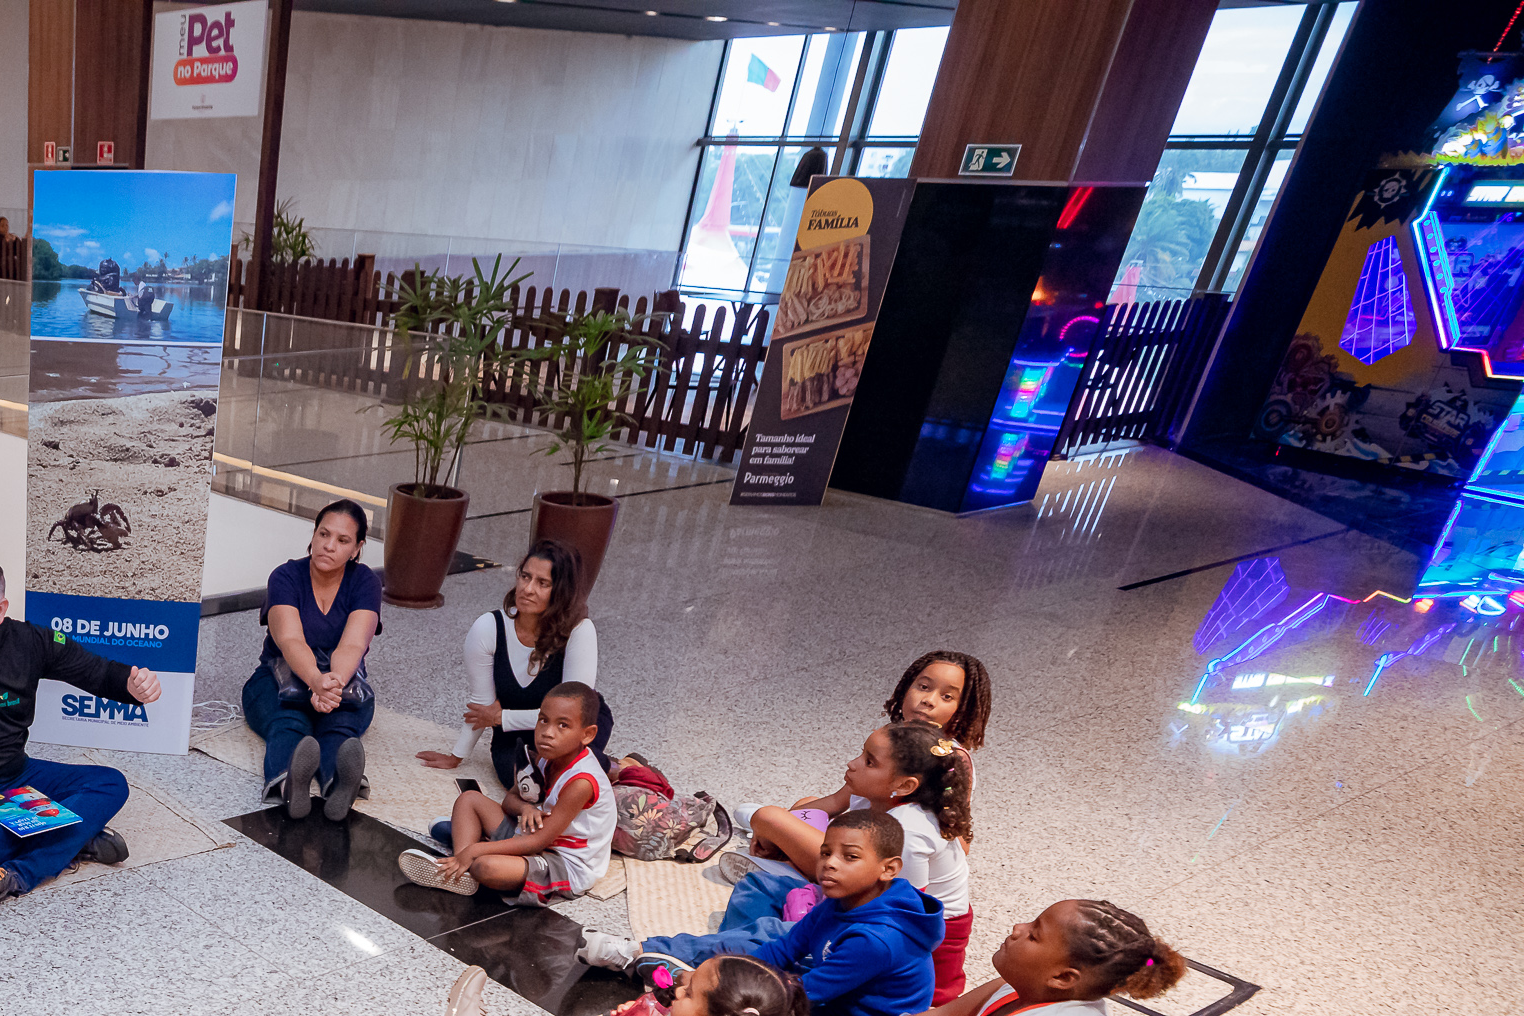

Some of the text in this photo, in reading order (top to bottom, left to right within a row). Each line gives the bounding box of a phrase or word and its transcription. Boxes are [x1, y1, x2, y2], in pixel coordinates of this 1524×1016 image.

[178, 14, 187, 56] meu
[187, 10, 235, 57] Pet
[177, 61, 233, 79] no Parque
[807, 214, 858, 230] FAMÍLIA
[756, 433, 816, 443] Tamanho ideal
[751, 445, 810, 455] para saborear
[744, 472, 794, 486] Parmeggio
[51, 616, 170, 640] 08 DE JUNHO
[72, 634, 163, 649] MUNDIAL DO OCEANO
[60, 693, 149, 723] SEMMA
